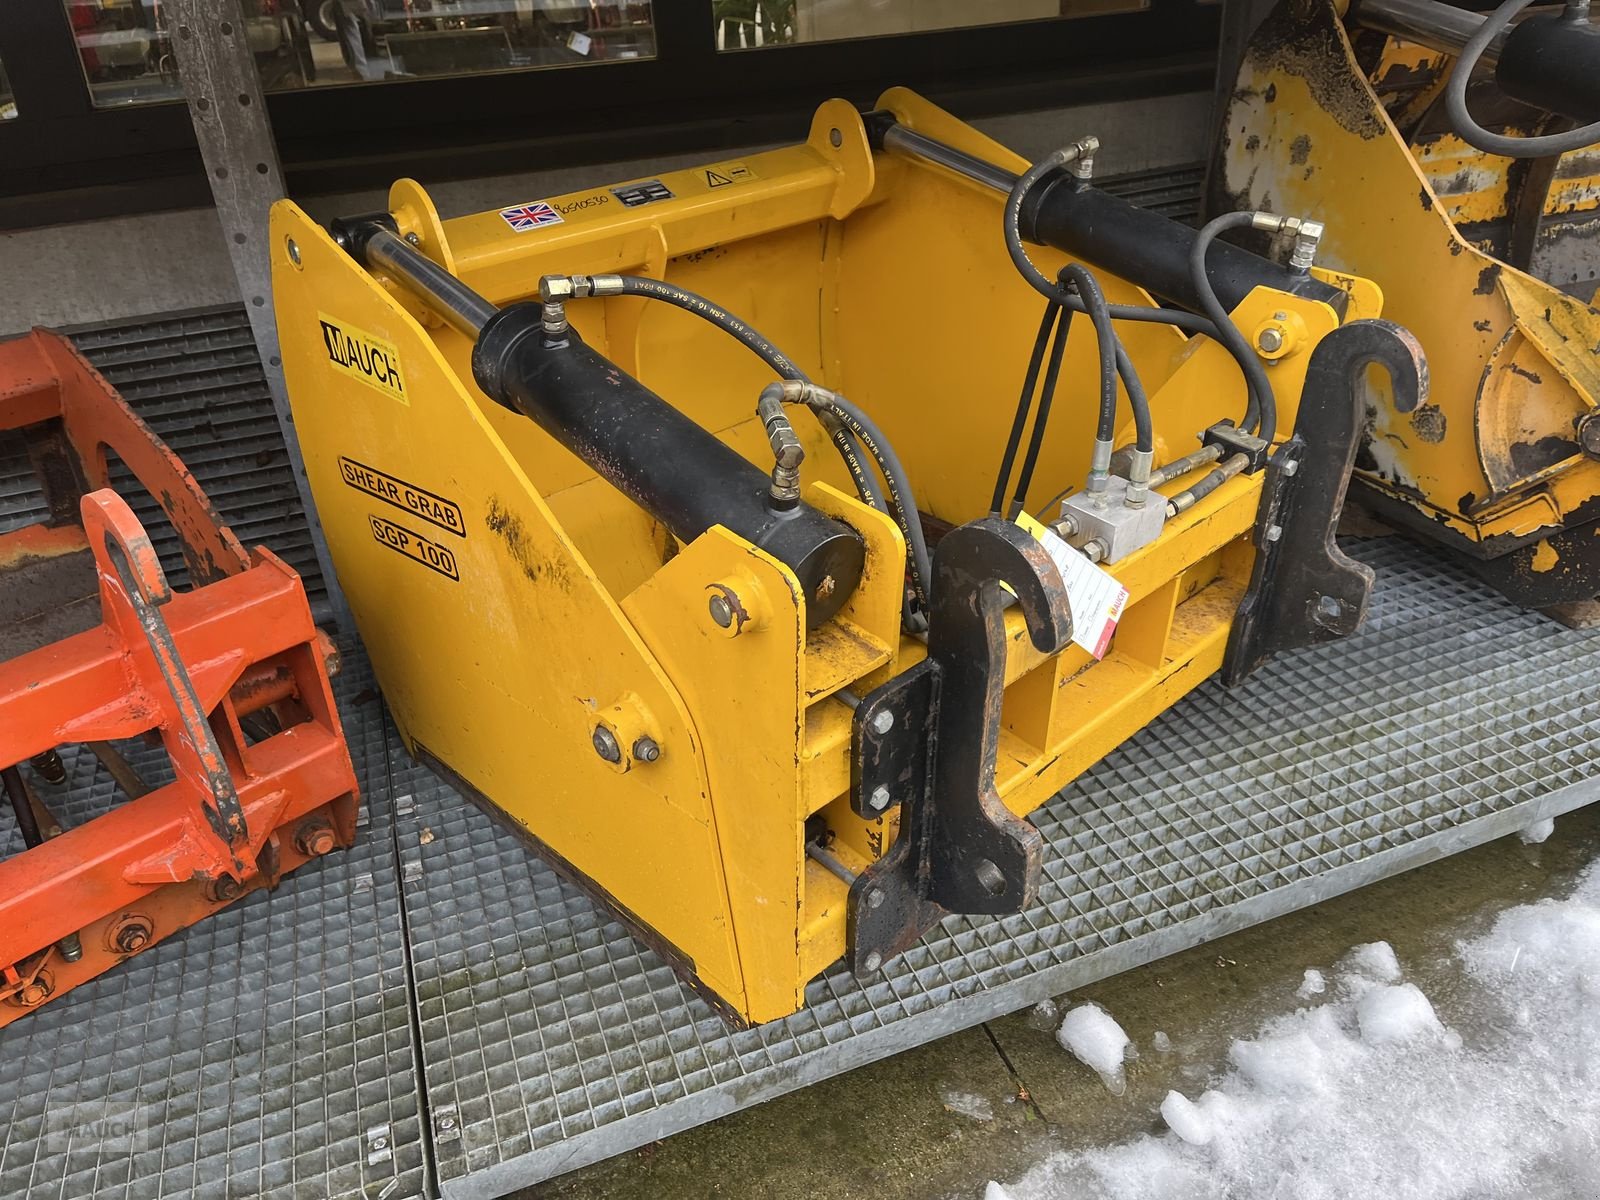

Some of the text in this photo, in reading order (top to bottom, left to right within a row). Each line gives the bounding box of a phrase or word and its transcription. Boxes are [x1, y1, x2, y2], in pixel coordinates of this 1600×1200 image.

[656, 286, 670, 295] 100
[320, 320, 402, 392] MAUCH
[830, 404, 852, 423] ITALY
[852, 421, 862, 432] IN
[842, 443, 851, 452] IN
[861, 431, 879, 455] MADE
[344, 463, 457, 527] SHEAR GRAB
[373, 519, 453, 573] SGP 100
[1110, 590, 1126, 617] MAUCH
